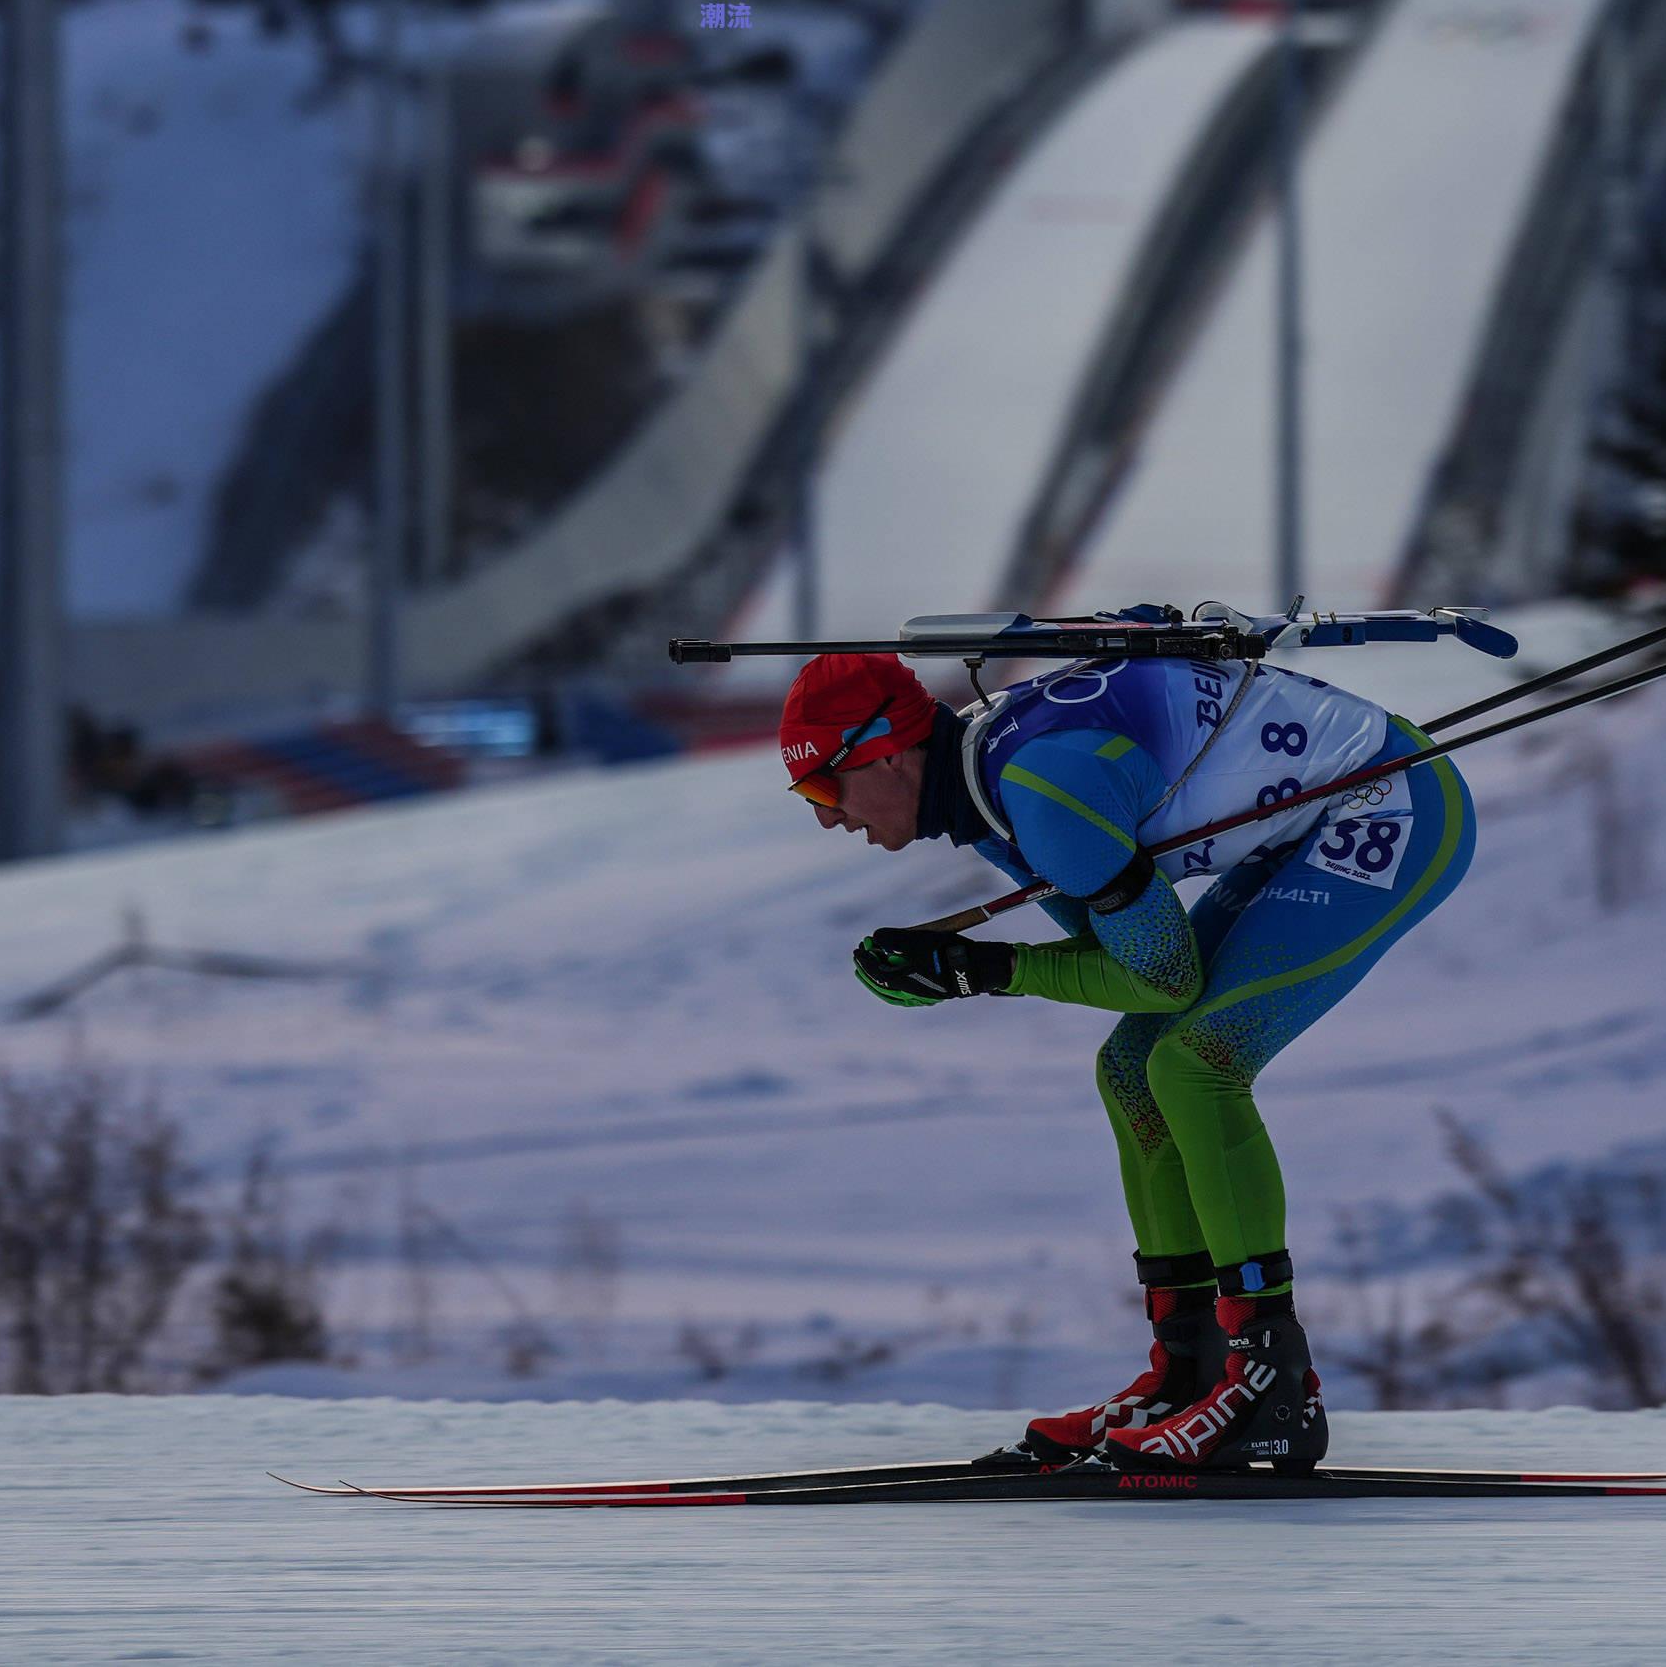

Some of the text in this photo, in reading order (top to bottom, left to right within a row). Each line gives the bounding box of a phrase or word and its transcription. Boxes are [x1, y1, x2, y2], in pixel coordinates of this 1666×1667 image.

[1318, 818, 1401, 873] 38
[1325, 860, 1372, 881] BEIJING 2022
[1267, 887, 1331, 905] HALTI
[1273, 1439, 1289, 1455] 3.0
[1117, 1474, 1198, 1490] ATOMIC
